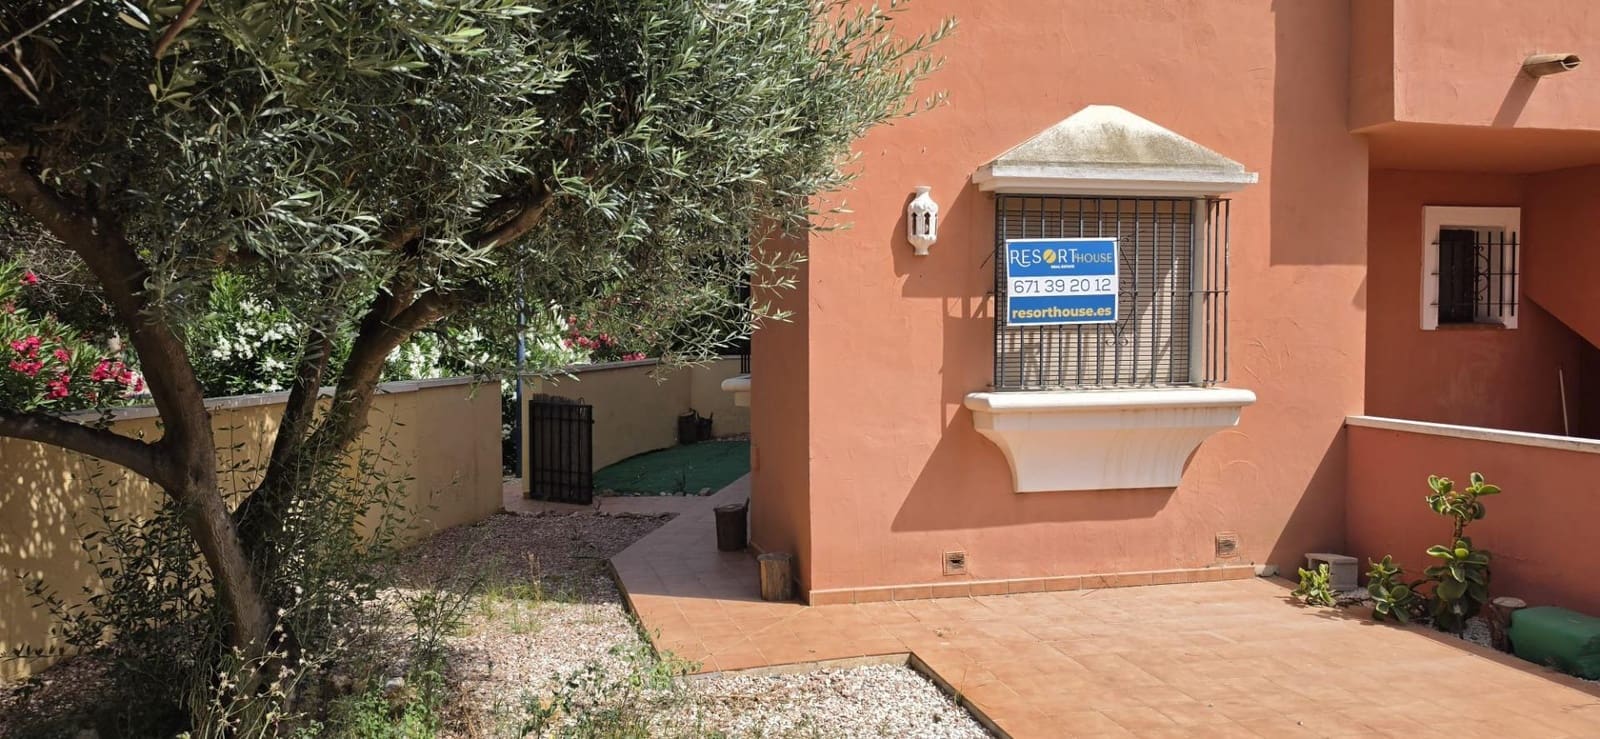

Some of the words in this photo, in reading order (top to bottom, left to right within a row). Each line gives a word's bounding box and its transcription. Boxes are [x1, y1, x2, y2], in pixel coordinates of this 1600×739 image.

[1014, 280, 1041, 293] 671
[1044, 279, 1065, 293] 39
[1070, 278, 1090, 292] 20
[1095, 278, 1111, 292] 12
[1012, 305, 1112, 319] resorthouse.es
